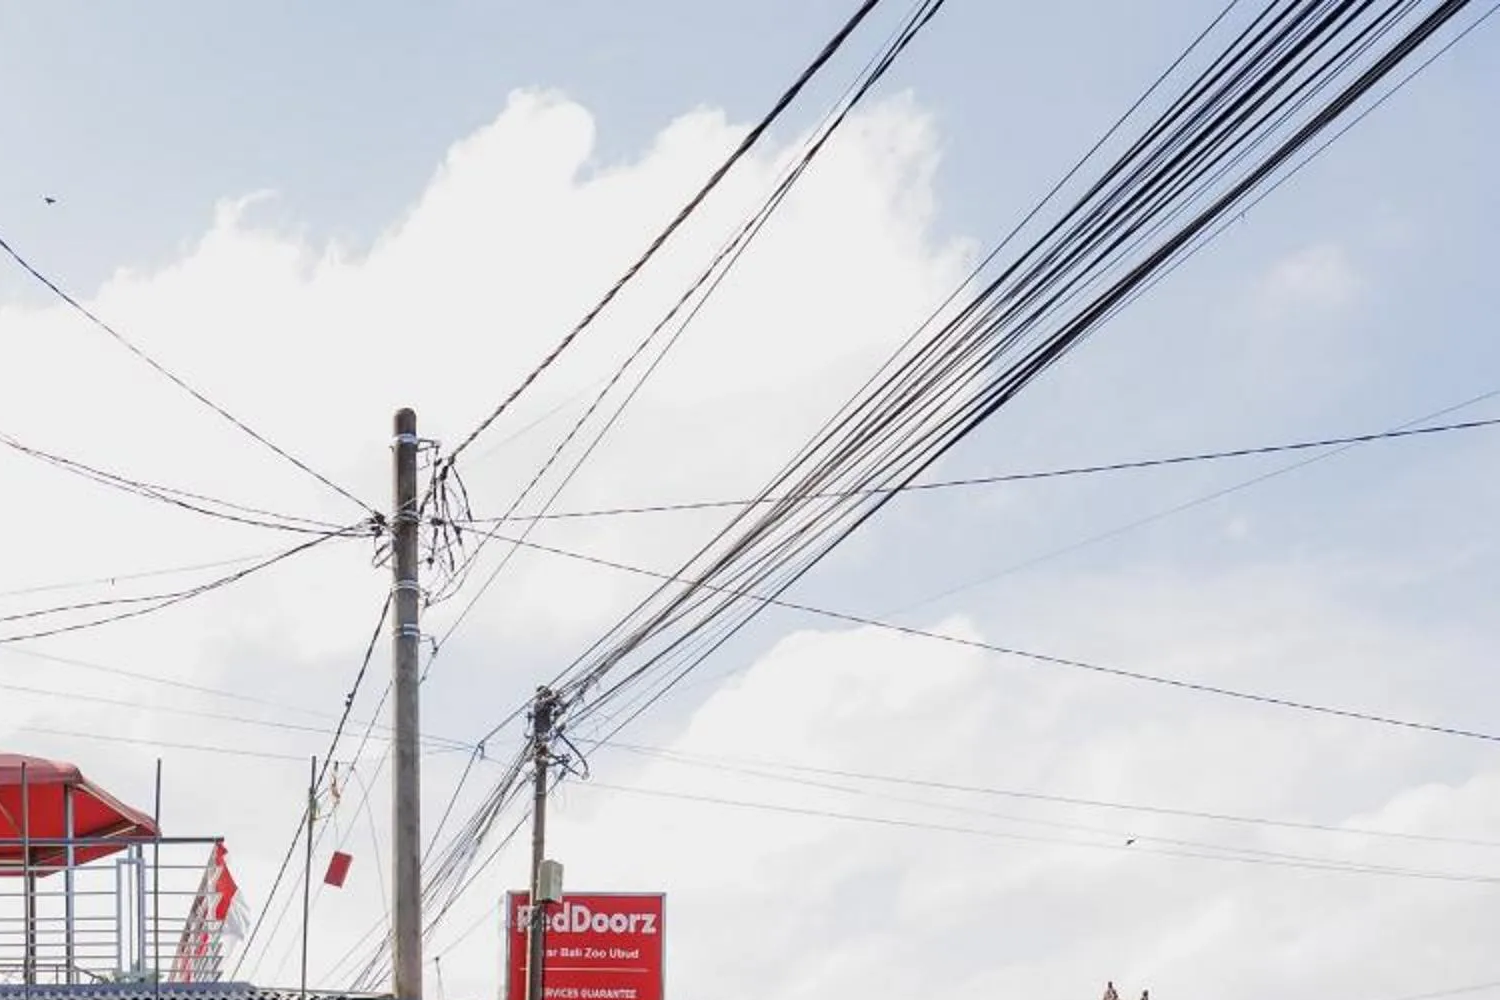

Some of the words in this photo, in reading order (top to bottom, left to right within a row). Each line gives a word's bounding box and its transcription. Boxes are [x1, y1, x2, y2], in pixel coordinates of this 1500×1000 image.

[516, 901, 656, 933] RdDoorz
[584, 947, 607, 958] Zoo
[609, 948, 639, 959] Ubud
